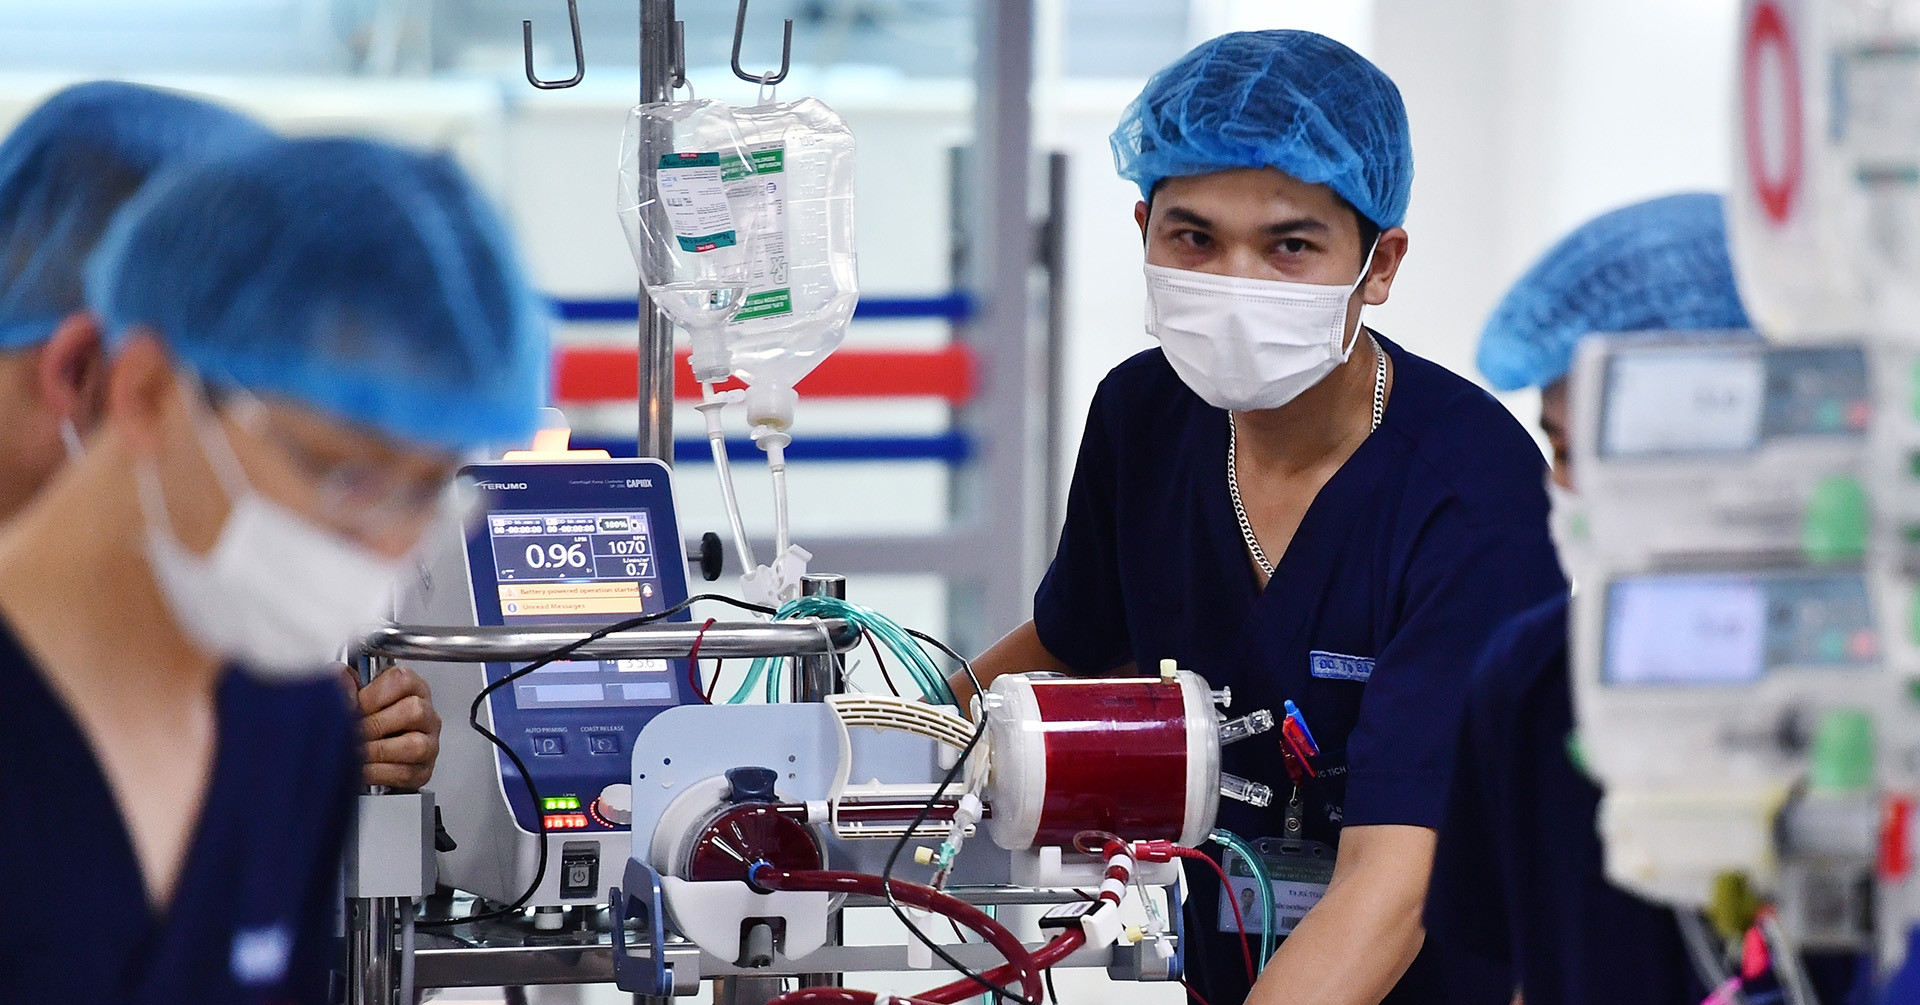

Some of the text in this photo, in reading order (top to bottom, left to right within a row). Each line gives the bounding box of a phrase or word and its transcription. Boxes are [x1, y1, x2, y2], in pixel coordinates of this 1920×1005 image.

[481, 482, 528, 490] TERUMO
[626, 478, 652, 488] CAPIOX
[604, 520, 628, 528] 100%
[608, 540, 645, 554] 1070
[526, 544, 586, 568] 0.96
[626, 563, 648, 576] 0.7
[580, 588, 613, 596] operation
[550, 602, 586, 611] Messages
